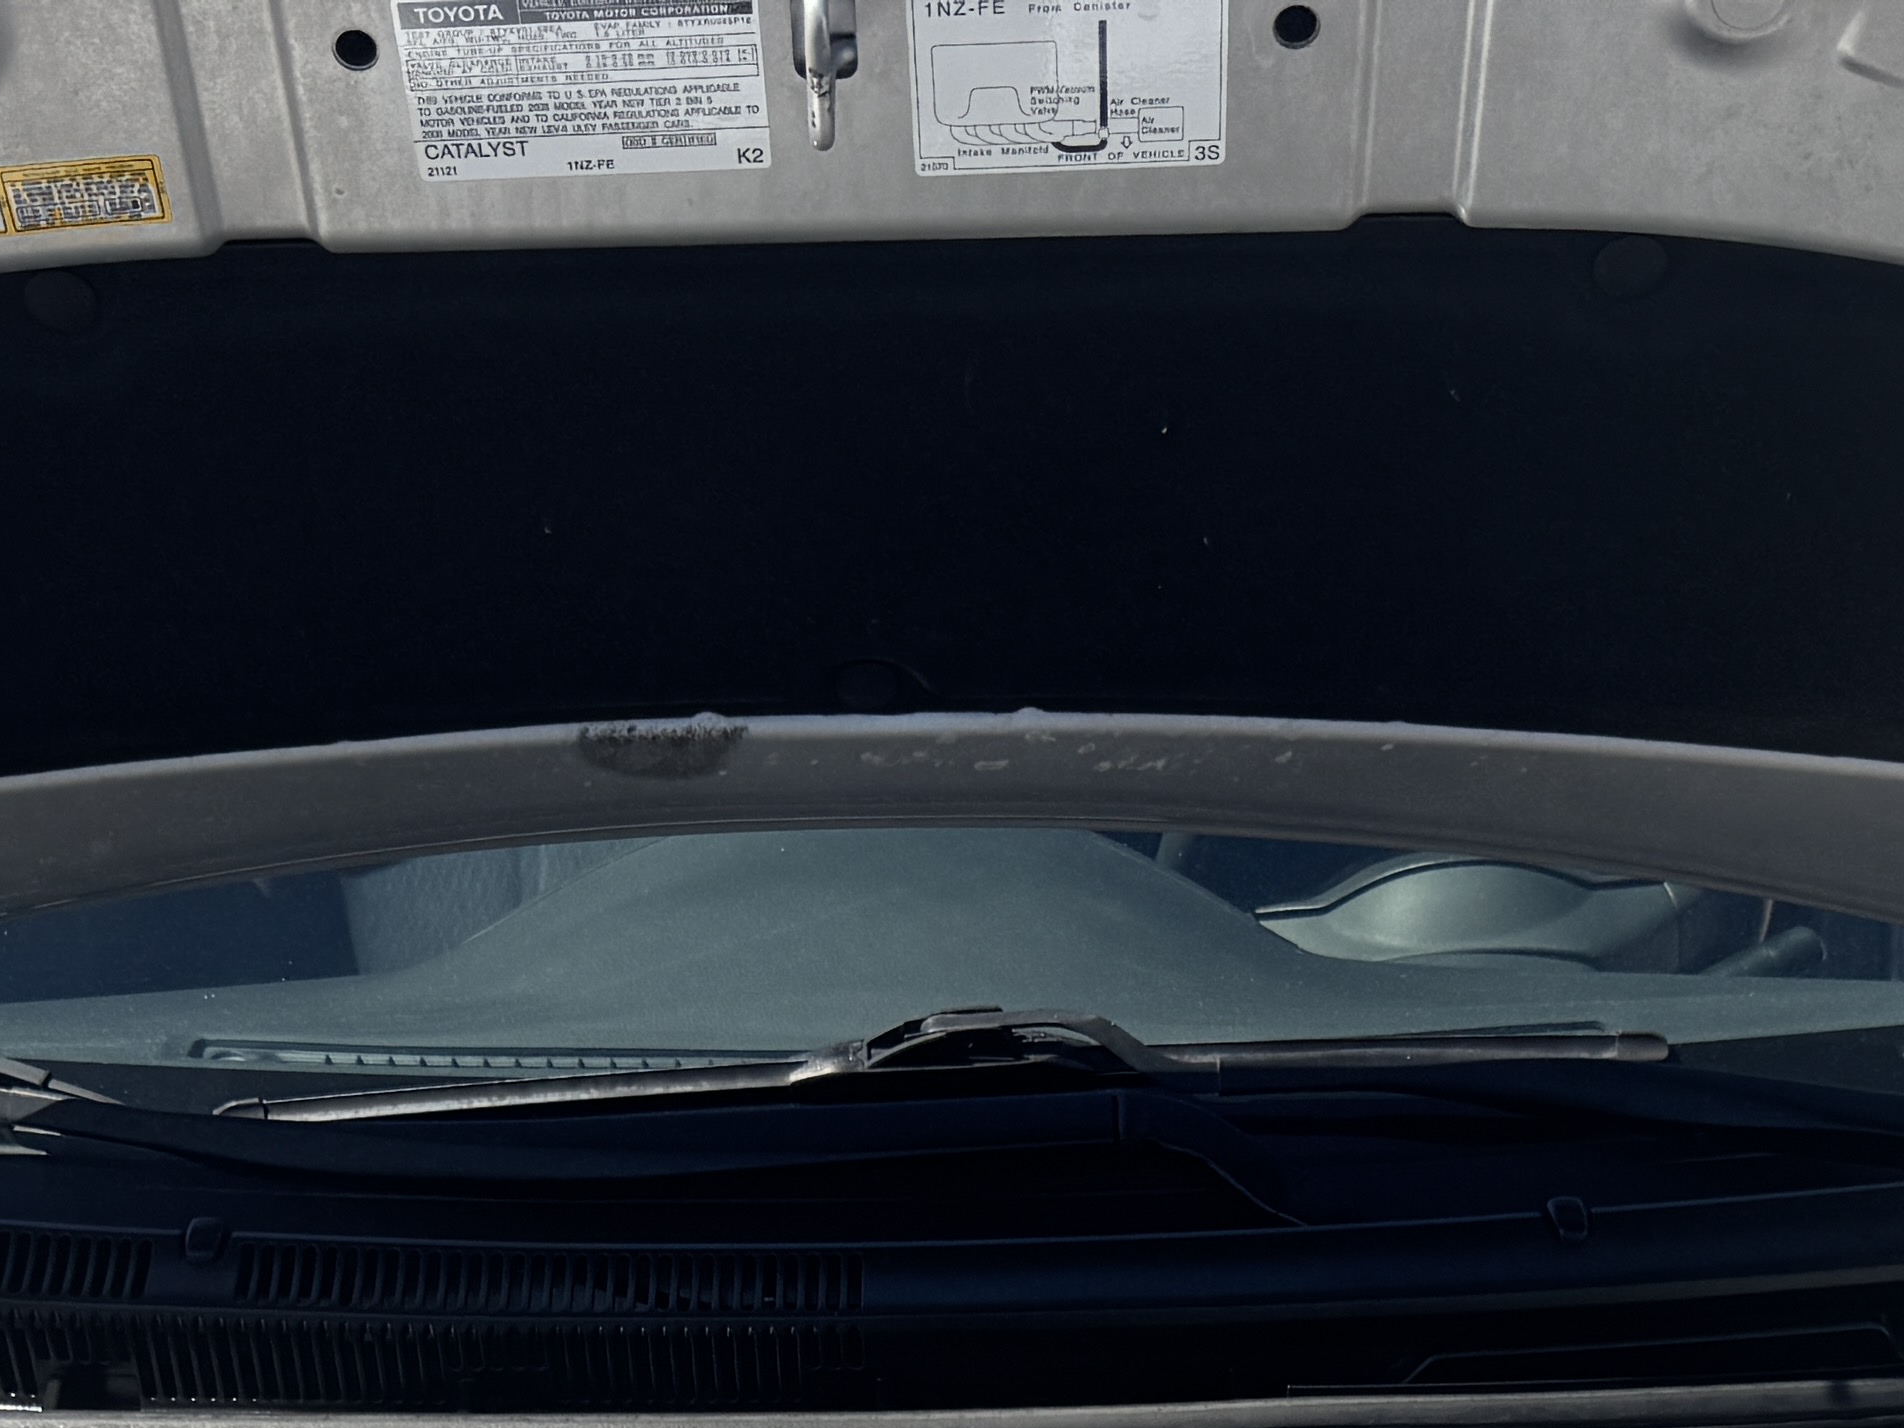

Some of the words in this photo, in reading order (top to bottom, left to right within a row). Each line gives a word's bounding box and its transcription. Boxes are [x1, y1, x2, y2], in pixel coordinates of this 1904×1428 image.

[414, 4, 504, 24] TOYOTA
[544, 10, 589, 20] TOYOTA
[593, 8, 636, 18] MOTOR
[641, 4, 729, 16] CORPORATION
[925, 0, 1005, 18] 1NZ-FE
[1028, 3, 1062, 14] From
[1073, 1, 1131, 12] Canister
[424, 140, 529, 160] CATALYST
[736, 148, 764, 164] K2
[1132, 150, 1185, 160] VEHICLE
[1194, 144, 1221, 161] 3S
[427, 166, 458, 177] 21121
[567, 159, 615, 171] 1NZ-FE
